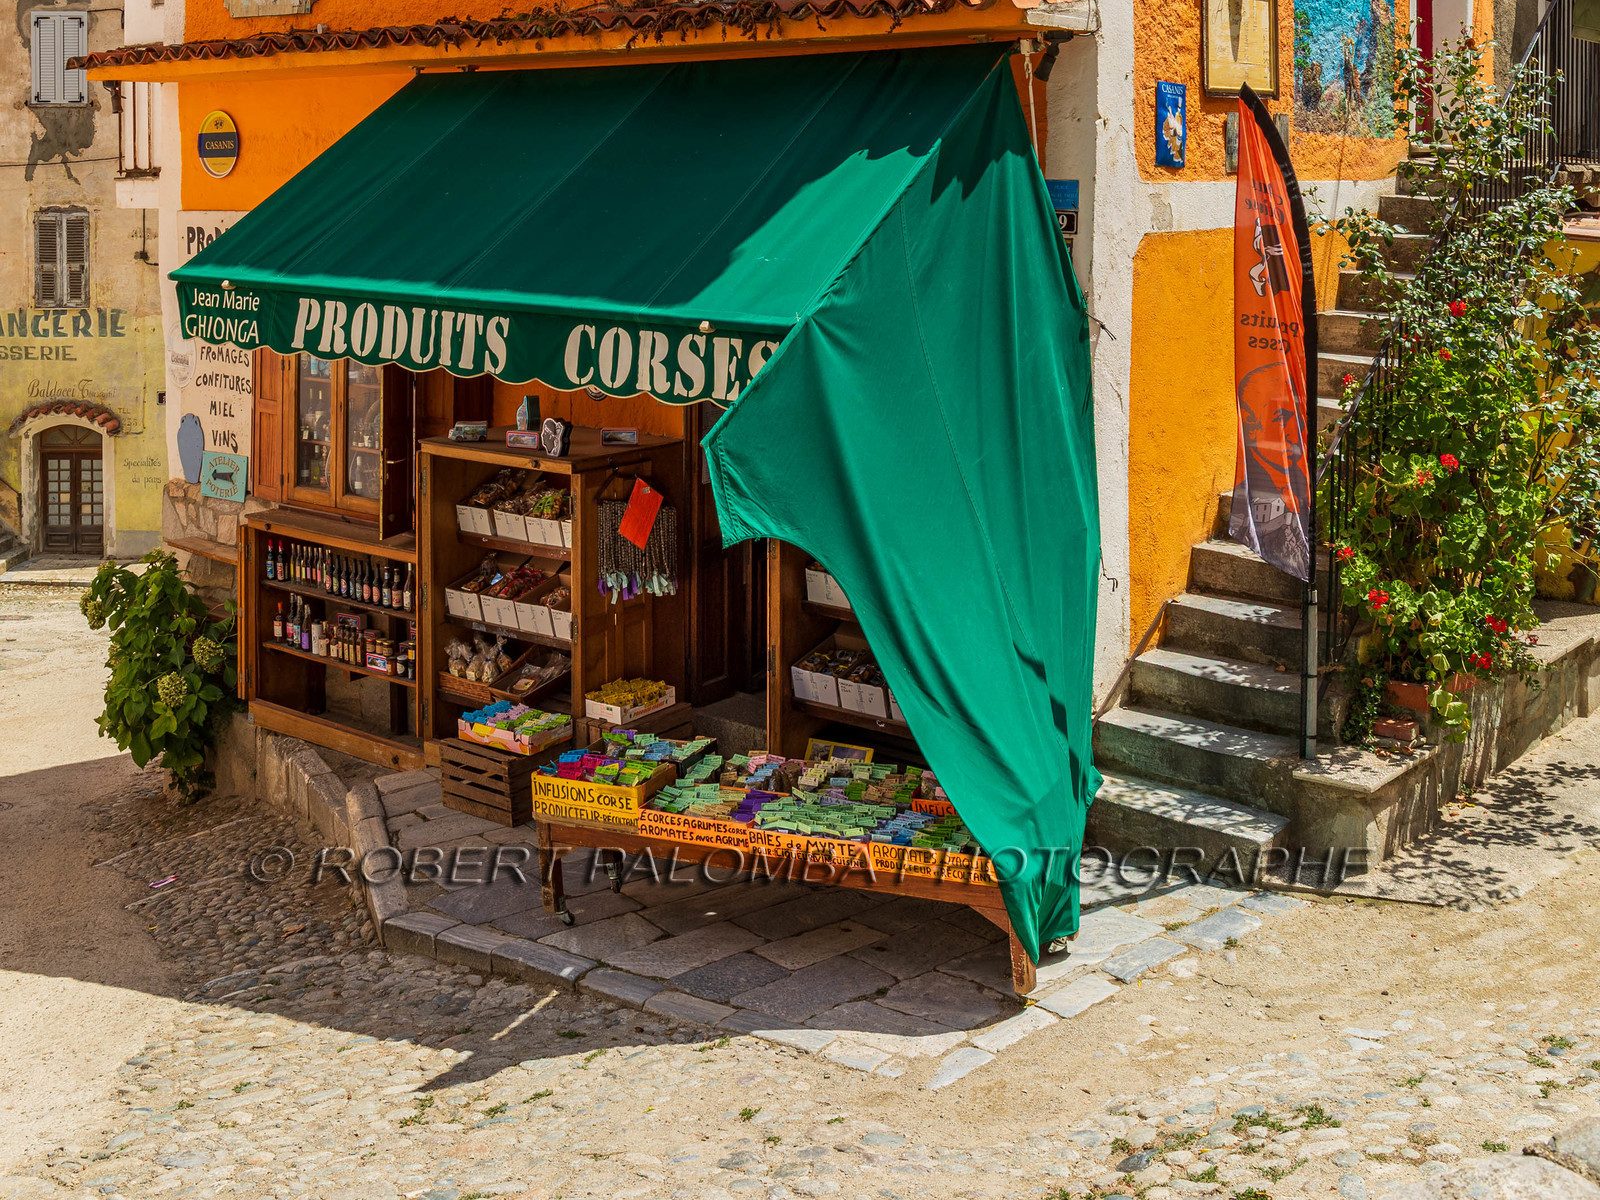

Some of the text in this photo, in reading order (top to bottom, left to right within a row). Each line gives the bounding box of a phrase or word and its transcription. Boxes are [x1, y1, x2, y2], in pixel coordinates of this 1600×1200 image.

[1161, 83, 1184, 96] CASANIS
[204, 140, 235, 150] CASANIS
[186, 226, 229, 255] PRO
[191, 287, 261, 312] Jean Marie
[184, 313, 260, 345] GHIONGA
[290, 296, 511, 375] PRODUITS
[199, 346, 250, 368] FROMAGES
[195, 371, 252, 395] CONFITURES
[209, 400, 235, 418] MIEL
[211, 429, 239, 454] VINS
[208, 455, 241, 474] ATELIER
[205, 478, 239, 498] POTERIE
[532, 776, 633, 811] INFUSIONS CORSE
[640, 823, 695, 841] AROMATES
[682, 818, 727, 833] AGRUMES
[786, 839, 802, 850] de
[806, 839, 857, 857] MYRTE
